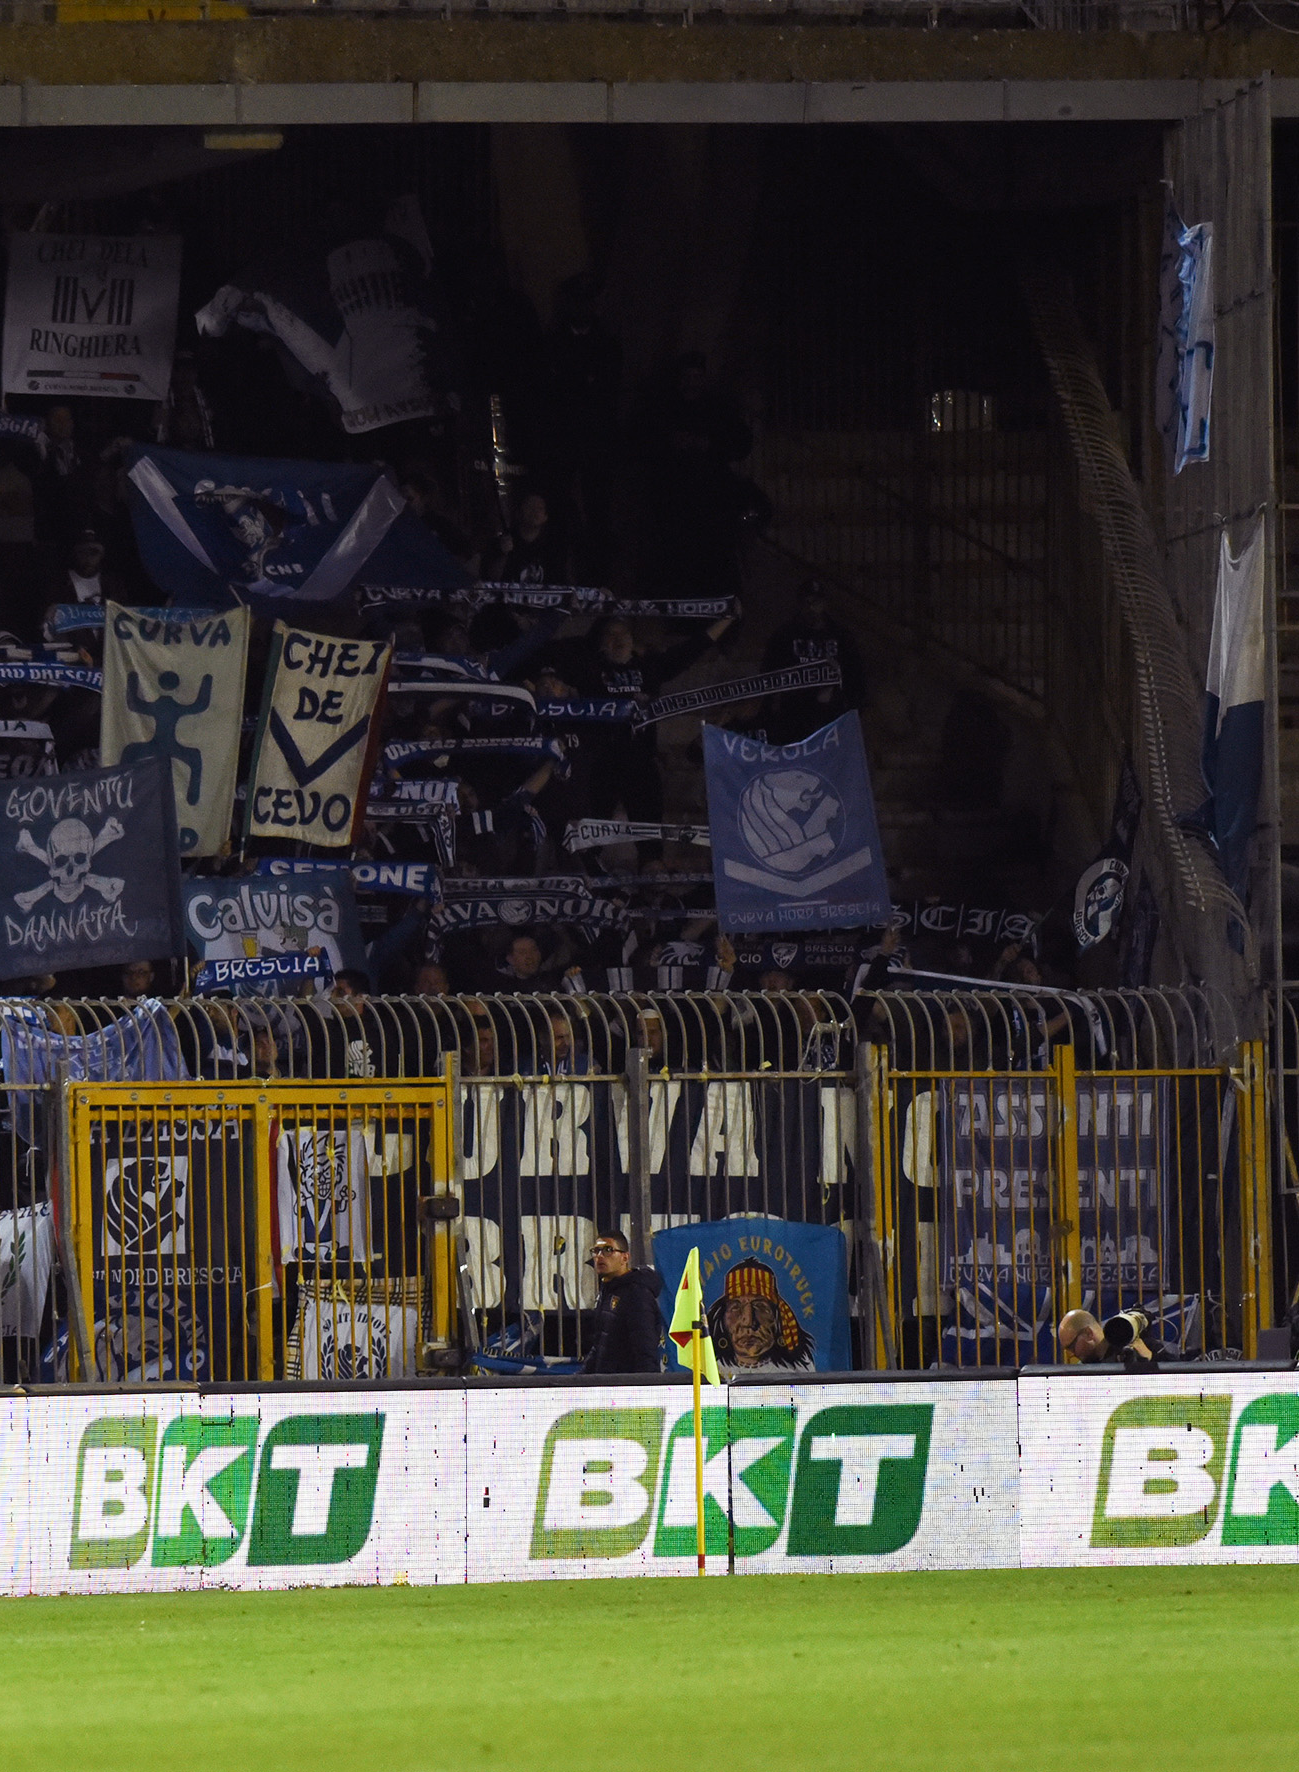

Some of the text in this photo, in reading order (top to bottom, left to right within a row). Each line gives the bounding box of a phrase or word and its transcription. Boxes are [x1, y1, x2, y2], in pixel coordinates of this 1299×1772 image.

[28, 327, 143, 358] RINGHIERA
[113, 615, 232, 649] CURVA
[282, 632, 390, 679] CHEI
[293, 687, 346, 725] DE
[722, 725, 841, 763] VEROLA
[252, 786, 353, 833] CEVO
[3, 898, 139, 953] DANNATA
[803, 944, 855, 954] BRESCIA
[803, 954, 853, 966] CALCIO
[214, 955, 320, 983] BRESCIA
[737, 1236, 816, 1320] EUROTRUCK
[75, 1440, 371, 1540] BKT
[543, 1431, 918, 1530] BKT
